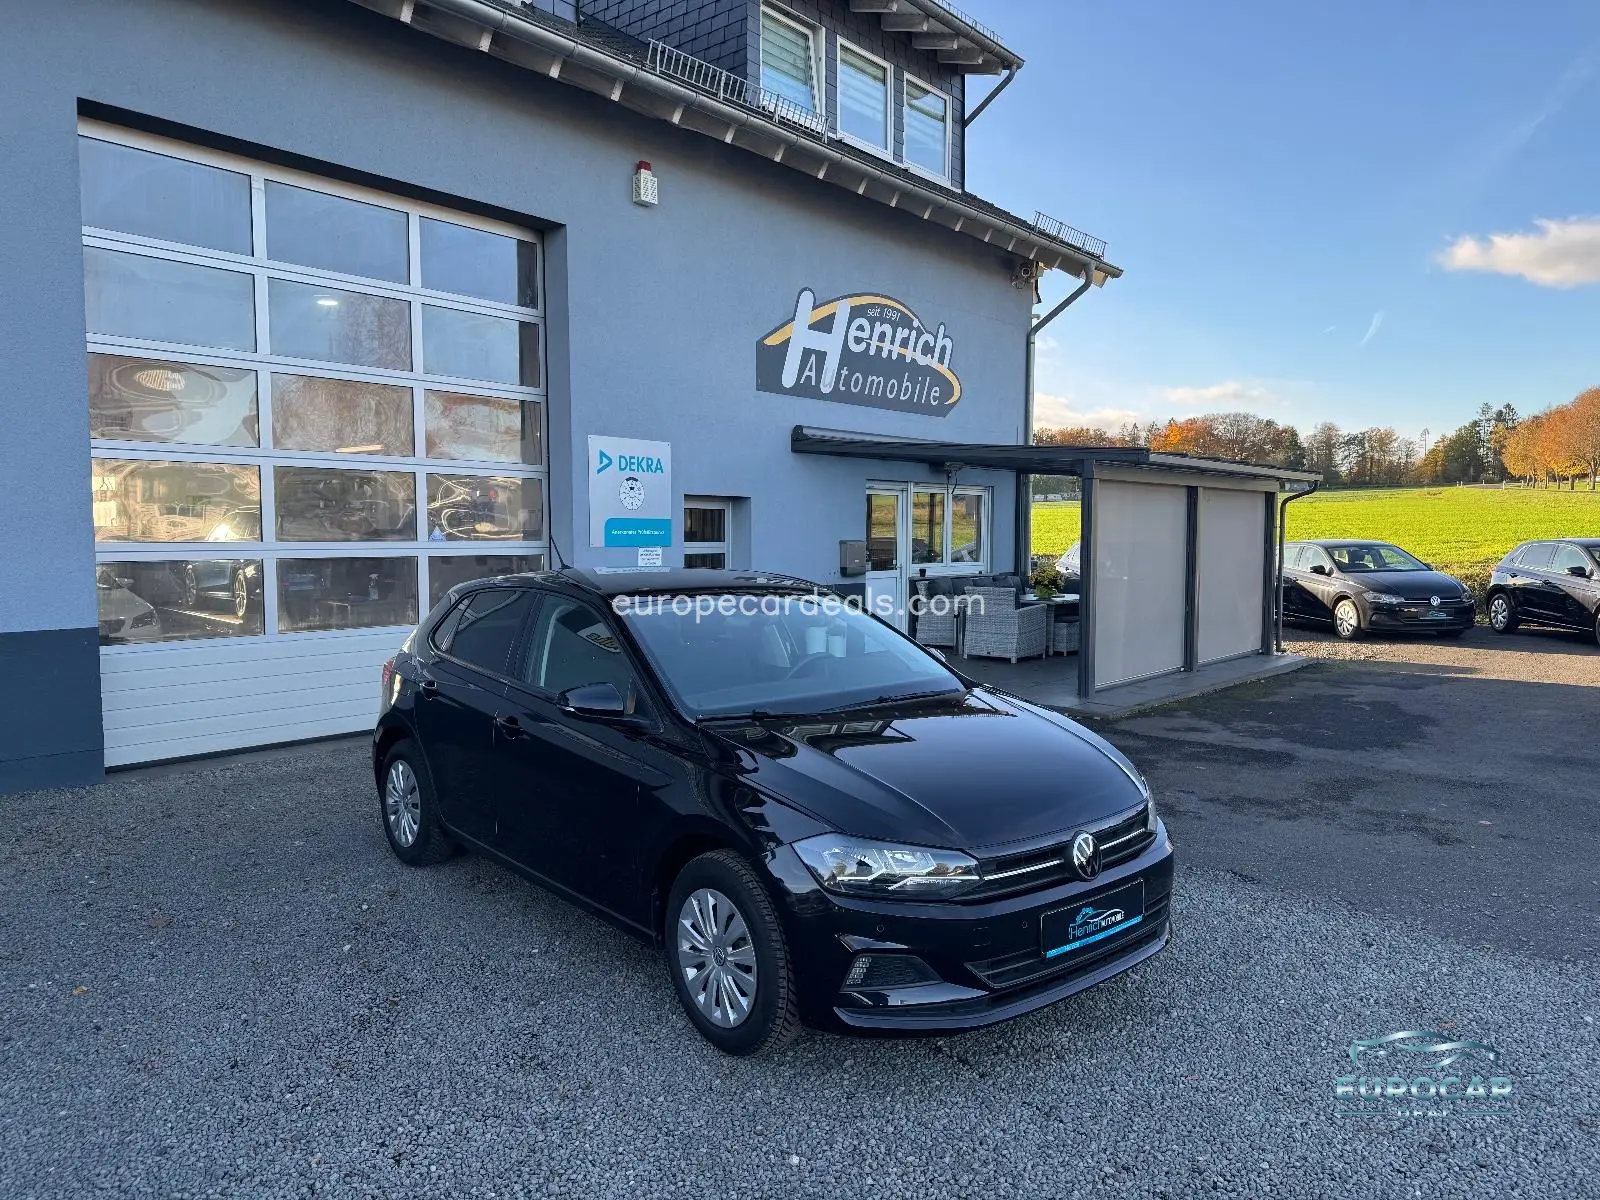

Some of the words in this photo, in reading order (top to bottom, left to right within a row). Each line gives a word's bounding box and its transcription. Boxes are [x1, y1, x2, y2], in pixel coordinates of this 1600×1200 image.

[867, 306, 881, 316] seit
[882, 306, 900, 321] 1991
[781, 290, 953, 394] Henrich
[618, 454, 664, 474] DEKRA
